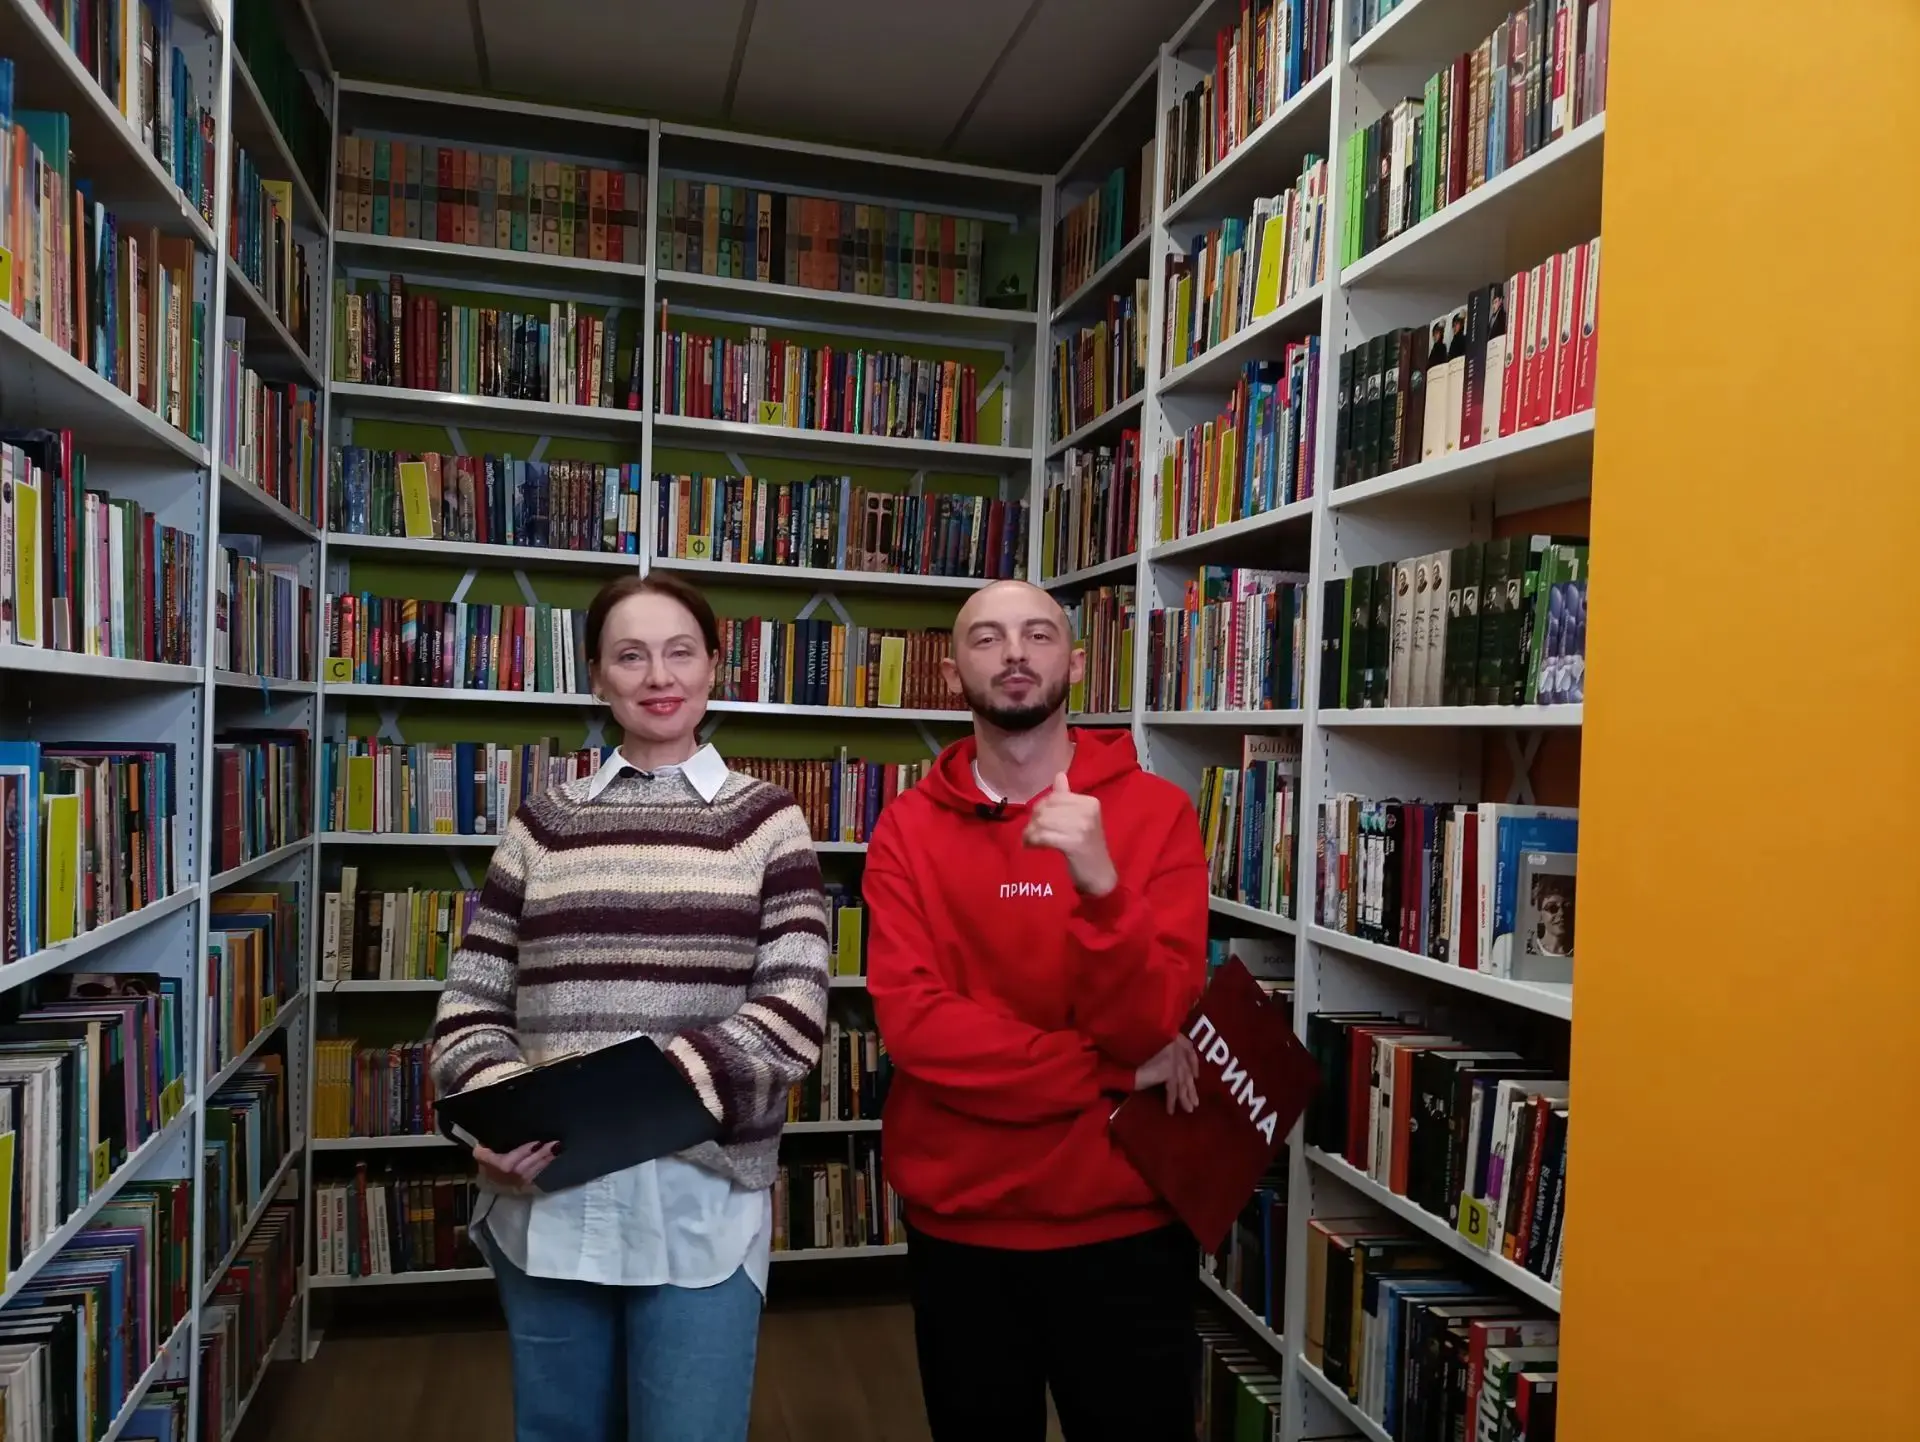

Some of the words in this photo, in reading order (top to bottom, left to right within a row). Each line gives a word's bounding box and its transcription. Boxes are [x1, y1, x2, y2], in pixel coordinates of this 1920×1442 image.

[765, 404, 777, 420] У
[692, 538, 706, 555] Ф
[333, 661, 345, 678] С
[1000, 882, 1053, 899] ПРИМА
[1187, 1013, 1278, 1146] ПРИМА
[1468, 1205, 1481, 1235] В
